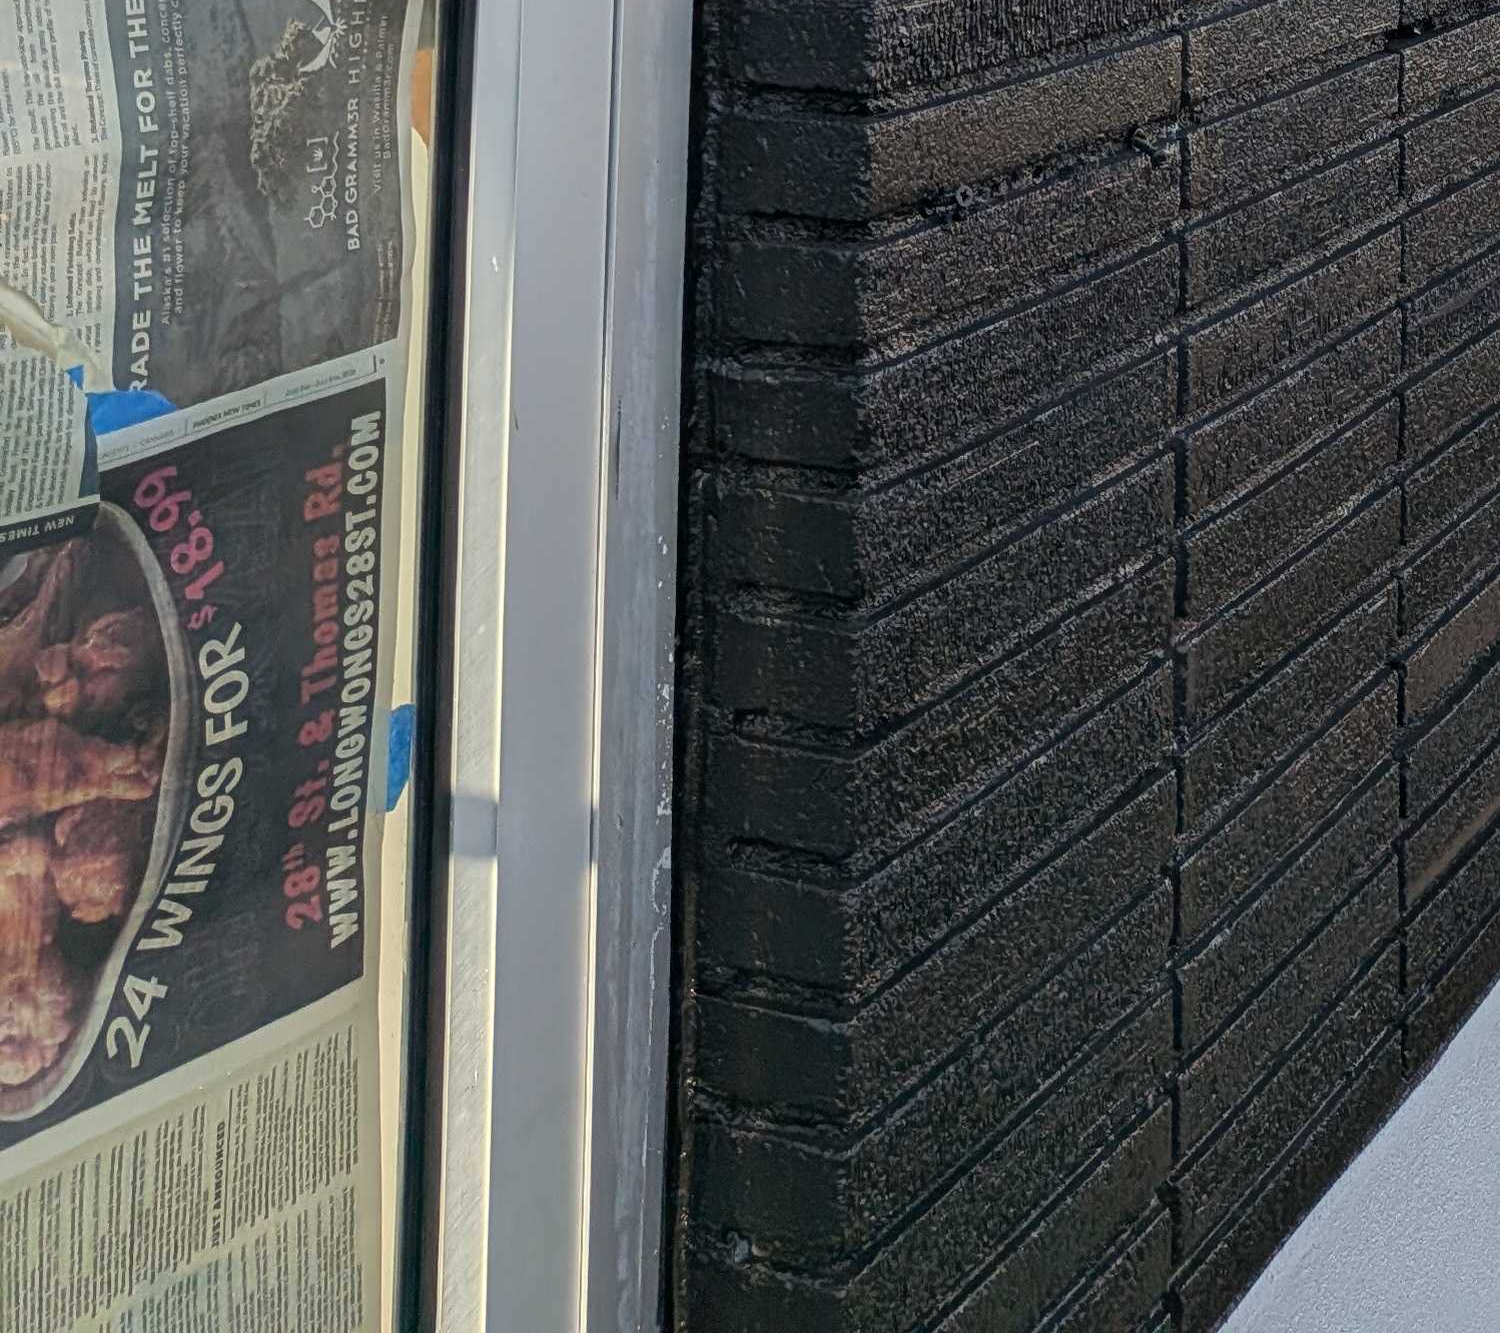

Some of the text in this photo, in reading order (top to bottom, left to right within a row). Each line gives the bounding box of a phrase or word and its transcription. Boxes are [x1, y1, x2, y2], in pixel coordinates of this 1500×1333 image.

[169, 13, 187, 74] perfectly
[133, 68, 159, 133] FOR
[164, 91, 180, 154] top-shelf
[179, 80, 191, 138] vacation
[133, 145, 159, 226] MELT
[167, 160, 177, 174] of
[180, 144, 190, 175] your
[345, 97, 361, 251] BAD GRAMM3R
[372, 161, 383, 192] Visit
[161, 178, 176, 242] selection
[172, 219, 182, 234] to
[175, 181, 187, 214] keep
[133, 236, 153, 301] THE
[173, 239, 185, 283] flower
[160, 268, 173, 326] Alaska's
[173, 288, 184, 314] and
[302, 443, 346, 523] Rd.
[44, 515, 75, 532] NEW
[298, 533, 340, 706] Thomas
[198, 620, 247, 748] FOR
[326, 410, 381, 949] WWW.LONGWONGS28ST.COM
[296, 709, 336, 748] &
[287, 759, 330, 828] St.
[136, 756, 243, 952] WINGS
[106, 973, 169, 1069] 24
[211, 1120, 226, 1249] JUST ANNOUNCED
